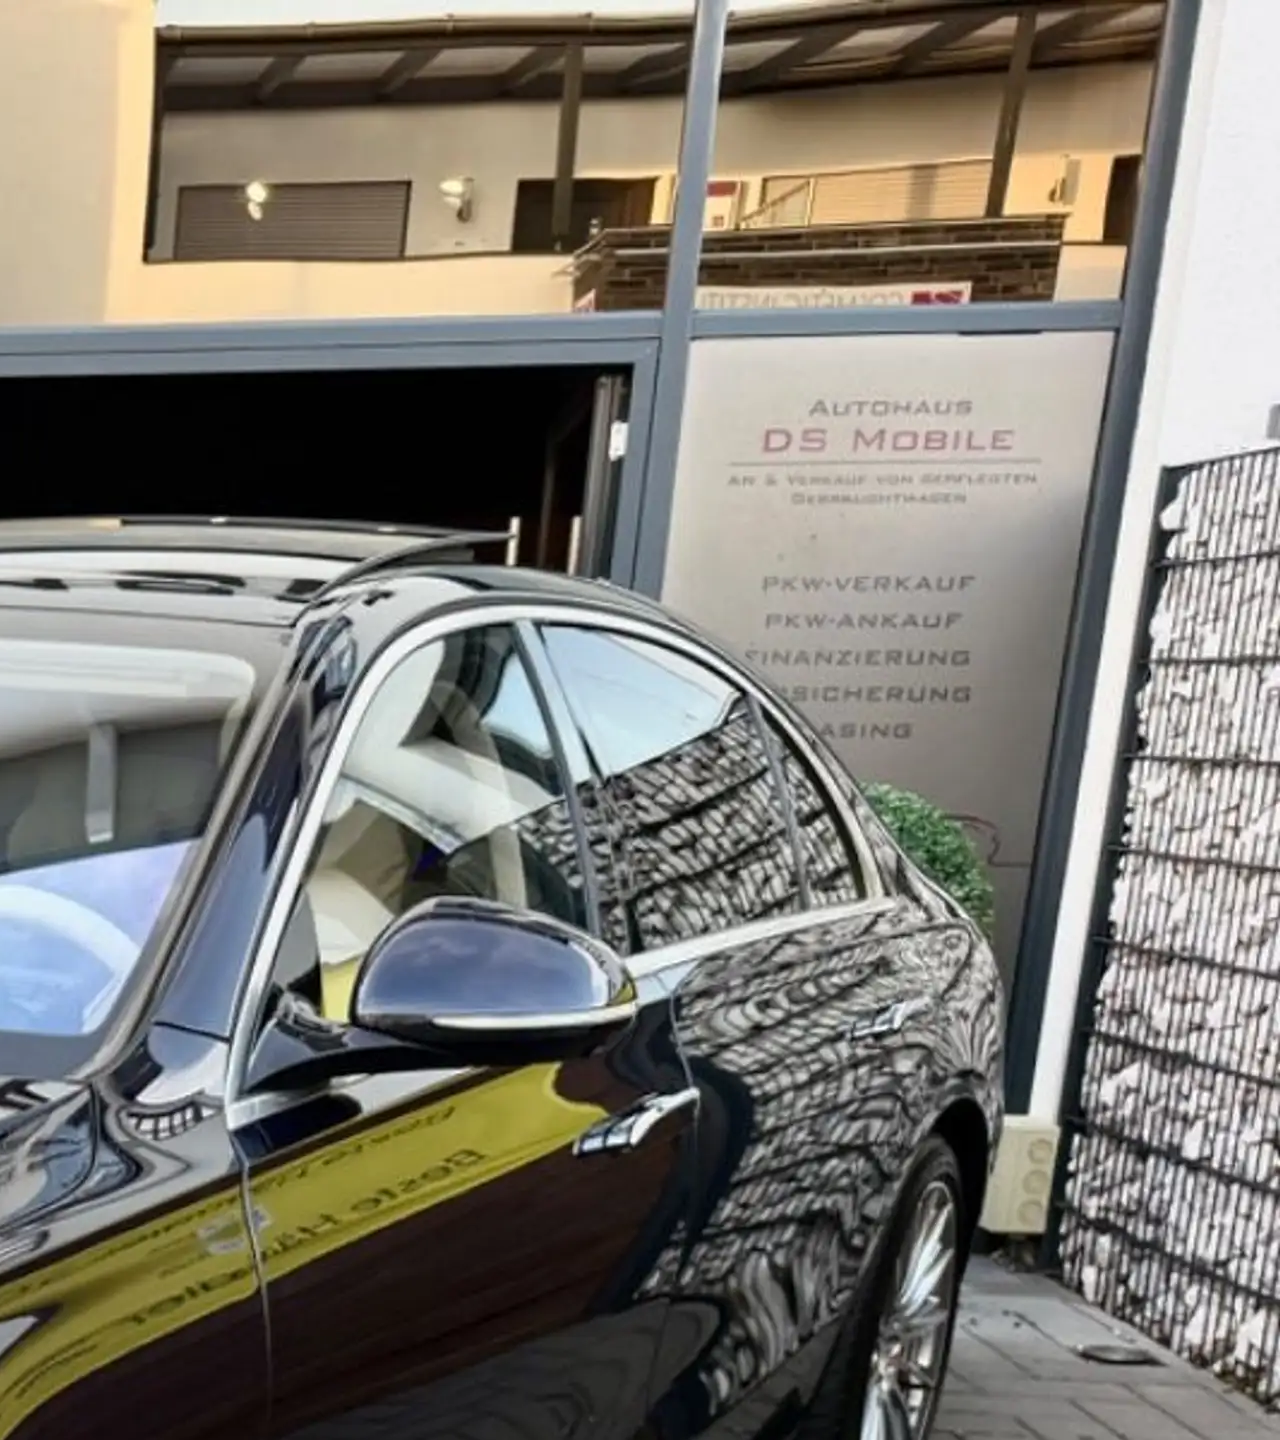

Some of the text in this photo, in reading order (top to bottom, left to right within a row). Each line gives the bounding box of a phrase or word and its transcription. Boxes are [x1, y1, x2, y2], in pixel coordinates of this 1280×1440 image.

[808, 398, 974, 417] AUTOHAUS
[761, 427, 1016, 453] DS MOBILE
